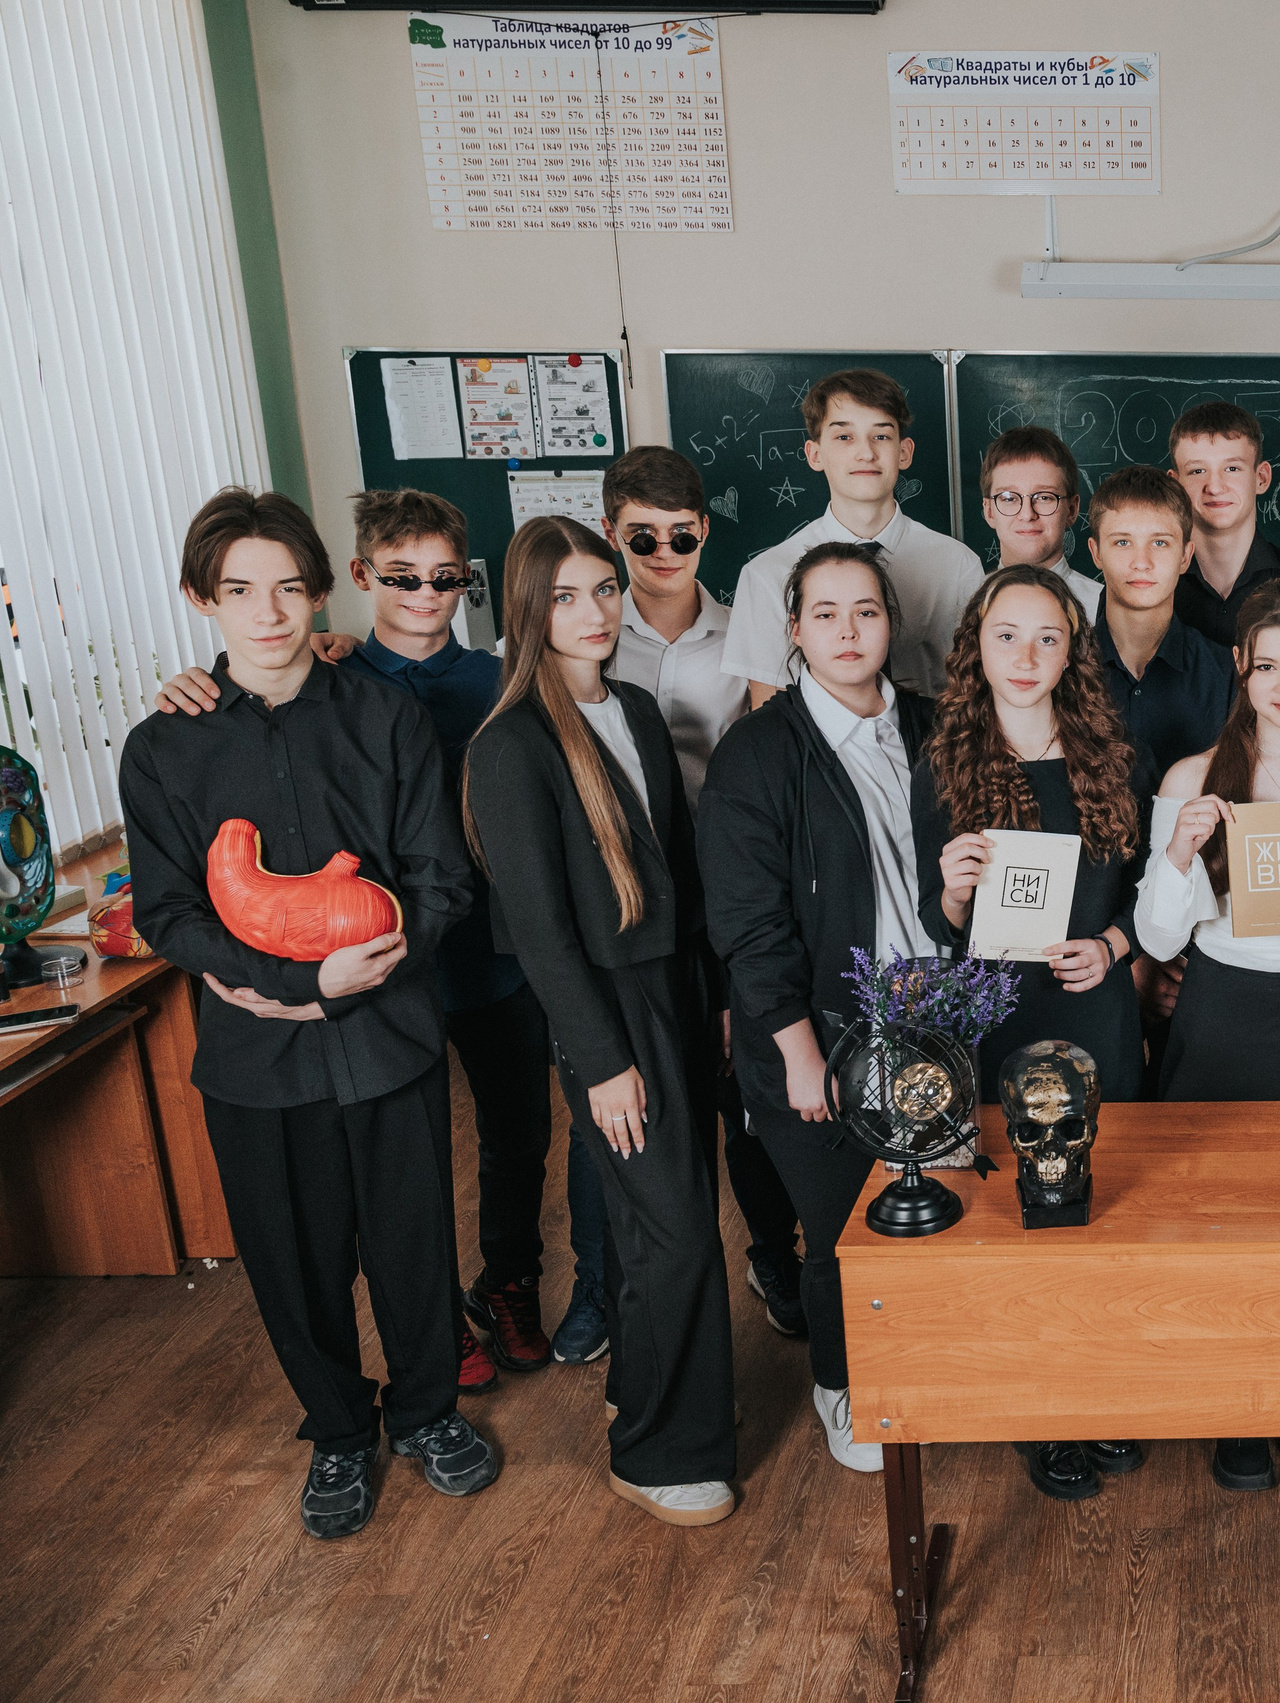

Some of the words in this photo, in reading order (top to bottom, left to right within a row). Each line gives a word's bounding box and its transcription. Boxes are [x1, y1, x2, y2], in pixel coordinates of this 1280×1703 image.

[492, 20, 552, 35] Таблица
[556, 21, 629, 36] квадратов
[453, 38, 547, 52] натуральных
[550, 38, 590, 50] чисел
[595, 40, 610, 49] от
[614, 37, 630, 50] 10
[634, 40, 651, 53] до
[656, 37, 672, 50] 99
[956, 58, 1030, 73] Квадраты
[1036, 60, 1044, 71] и
[1050, 60, 1088, 74] кубы
[910, 74, 1009, 88] натуральных
[1014, 74, 1056, 87] чисел
[1062, 75, 1077, 86] от
[1082, 74, 1090, 86] 1
[1095, 74, 1114, 88] до
[1119, 74, 1136, 86] 10
[487, 127, 503, 135] 961
[513, 127, 533, 135] 1024
[540, 127, 561, 135] 1089
[568, 127, 588, 136] 1156
[594, 128, 615, 136] 1225
[622, 128, 642, 136] 1296
[649, 128, 669, 136] 1369
[676, 128, 697, 136] 1444
[704, 128, 723, 137] 1152
[988, 140, 997, 148] 16
[1011, 140, 1021, 148] 25
[1035, 140, 1044, 148] 36
[1058, 140, 1068, 148] 49
[1082, 140, 1091, 148] 64
[1105, 140, 1114, 148] 81
[965, 161, 975, 169] 27
[1012, 161, 1026, 169] 125
[1036, 161, 1049, 169] 216
[1059, 161, 1073, 169] 343
[1083, 161, 1096, 169] 512
[495, 205, 515, 213] 6561
[521, 205, 542, 214] 6724
[575, 206, 596, 214] 7056
[602, 206, 623, 214] 7225
[629, 206, 650, 214] 7396
[656, 206, 677, 214] 7569
[682, 206, 703, 215] 7744
[709, 207, 729, 215] 7921
[1013, 873, 1040, 888] НИ
[1010, 888, 1038, 904] СЫ
